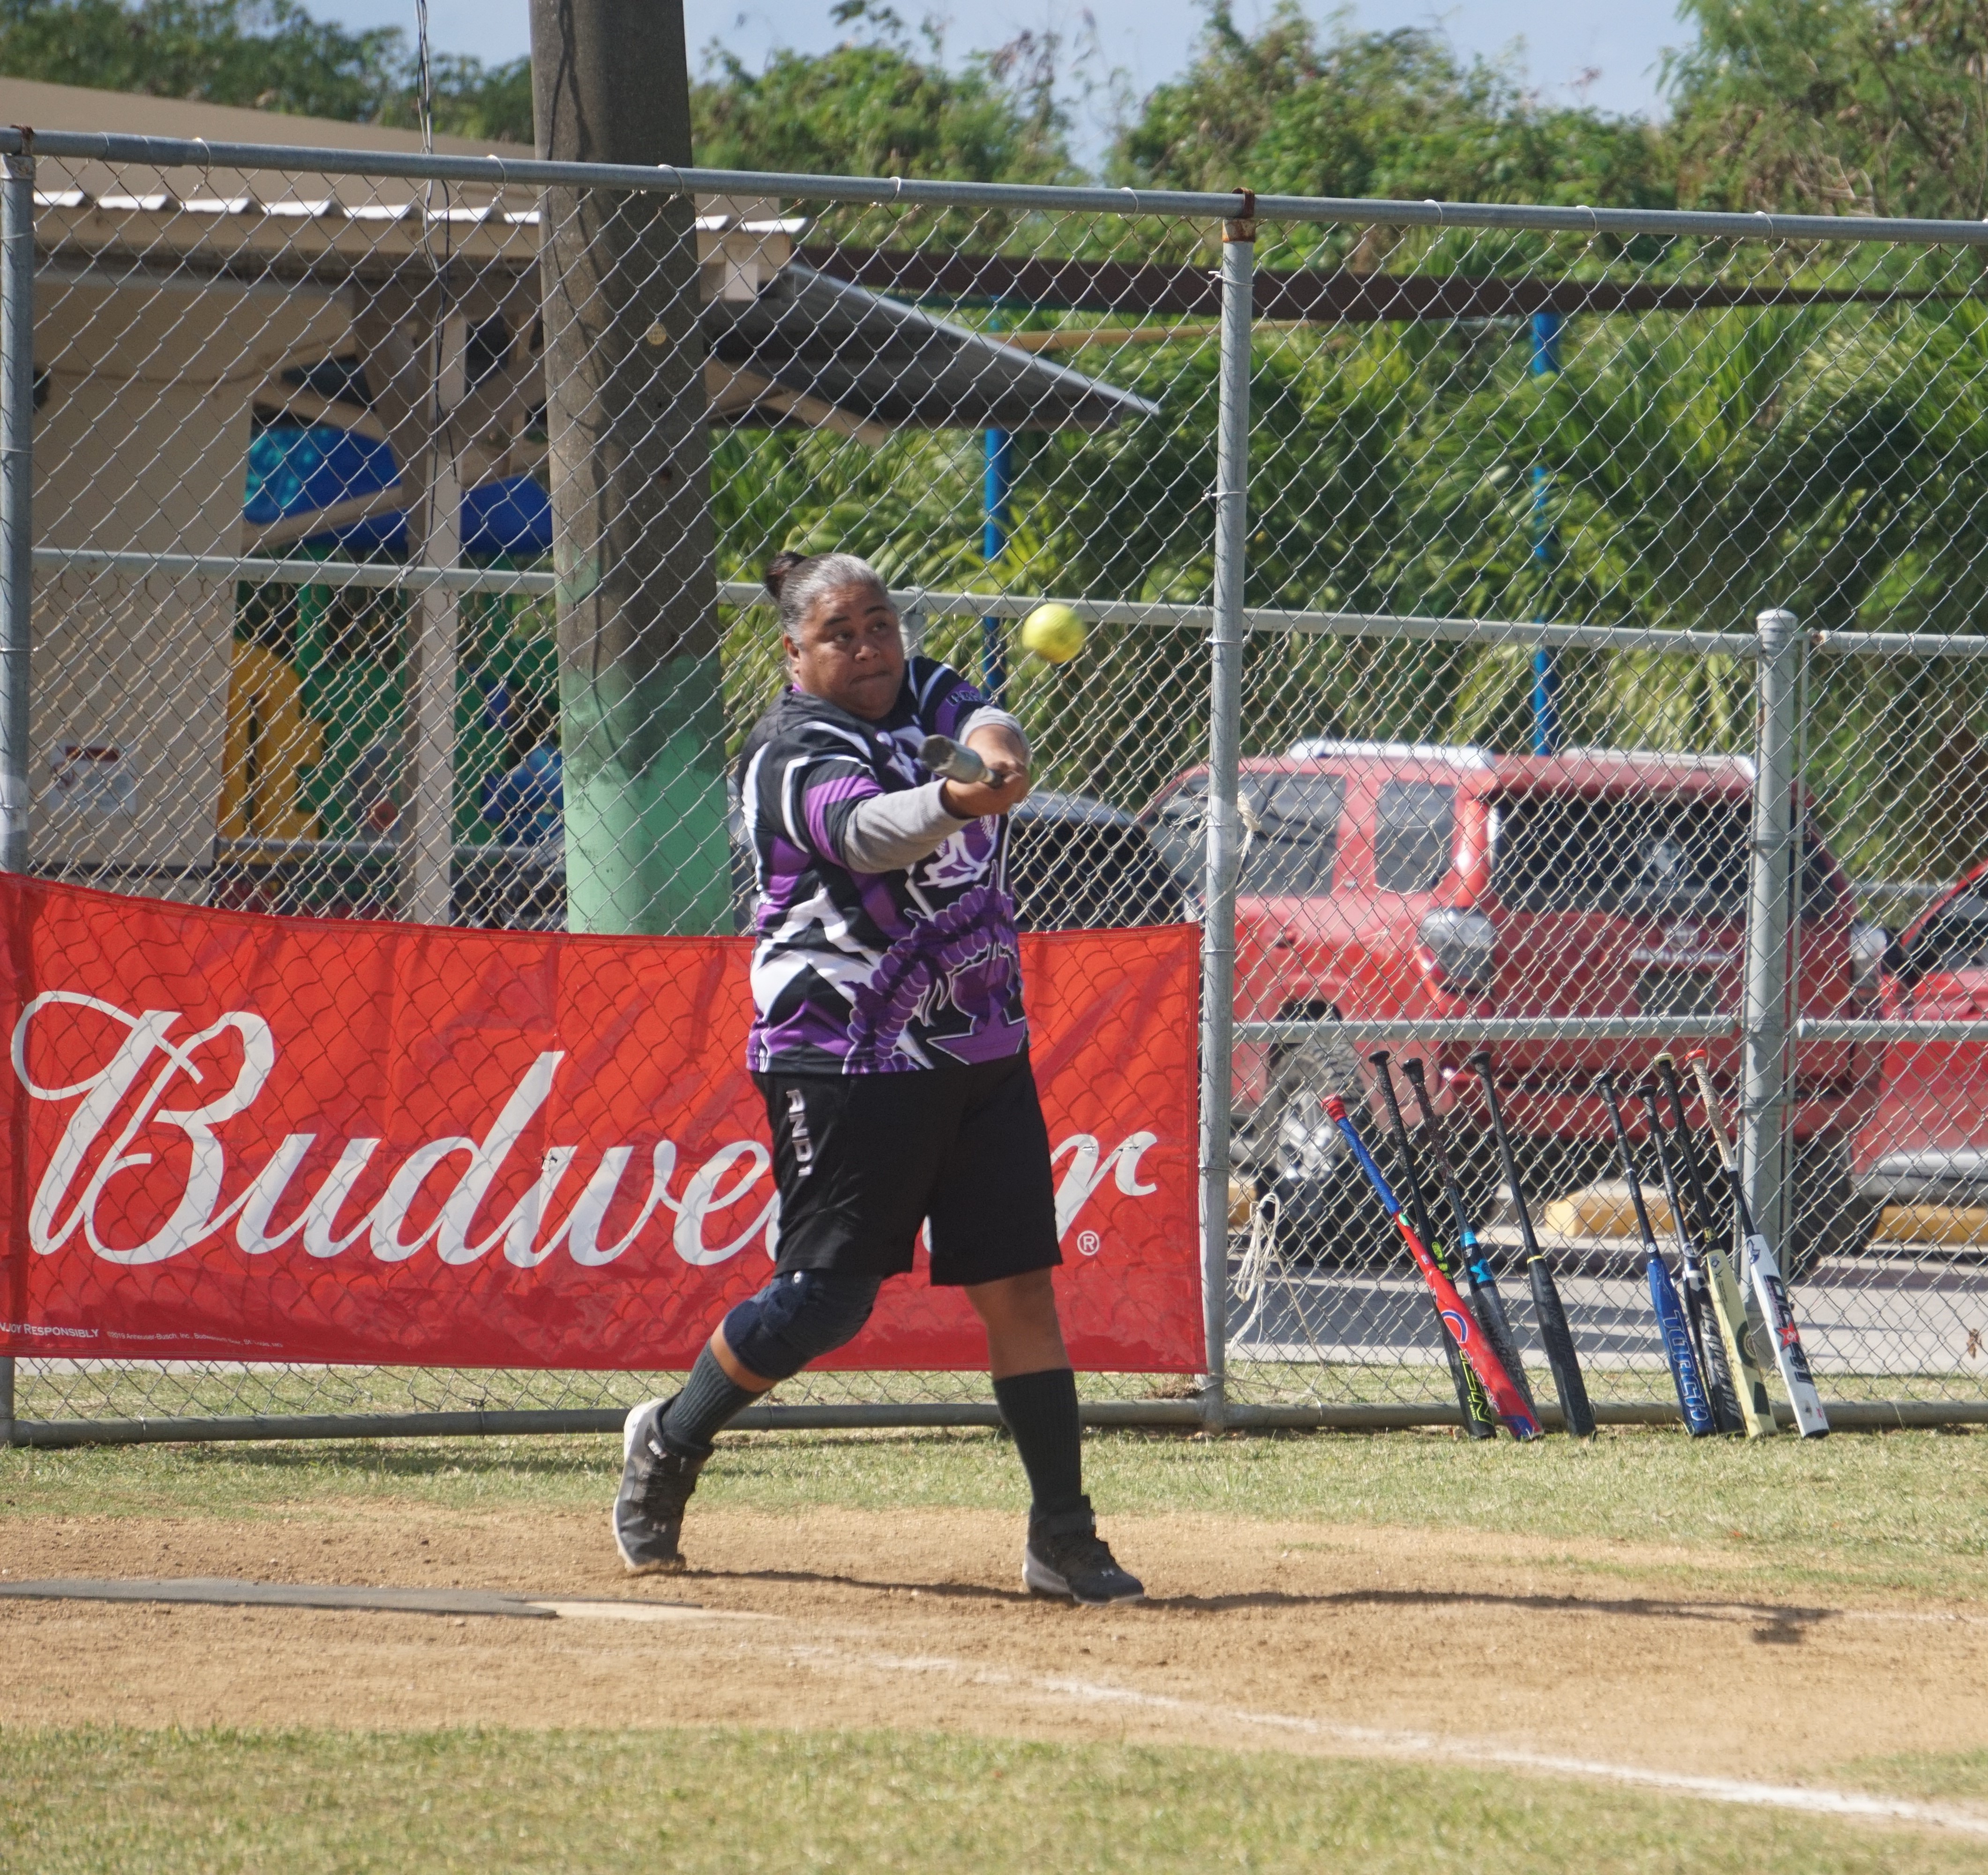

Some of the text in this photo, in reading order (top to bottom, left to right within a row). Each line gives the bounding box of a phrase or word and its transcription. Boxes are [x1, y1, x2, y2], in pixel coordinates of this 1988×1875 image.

[10, 990, 1157, 1267] Budwer
[786, 1089, 813, 1178] AND1
[23, 1323, 98, 1338] RESPONSIBLY
